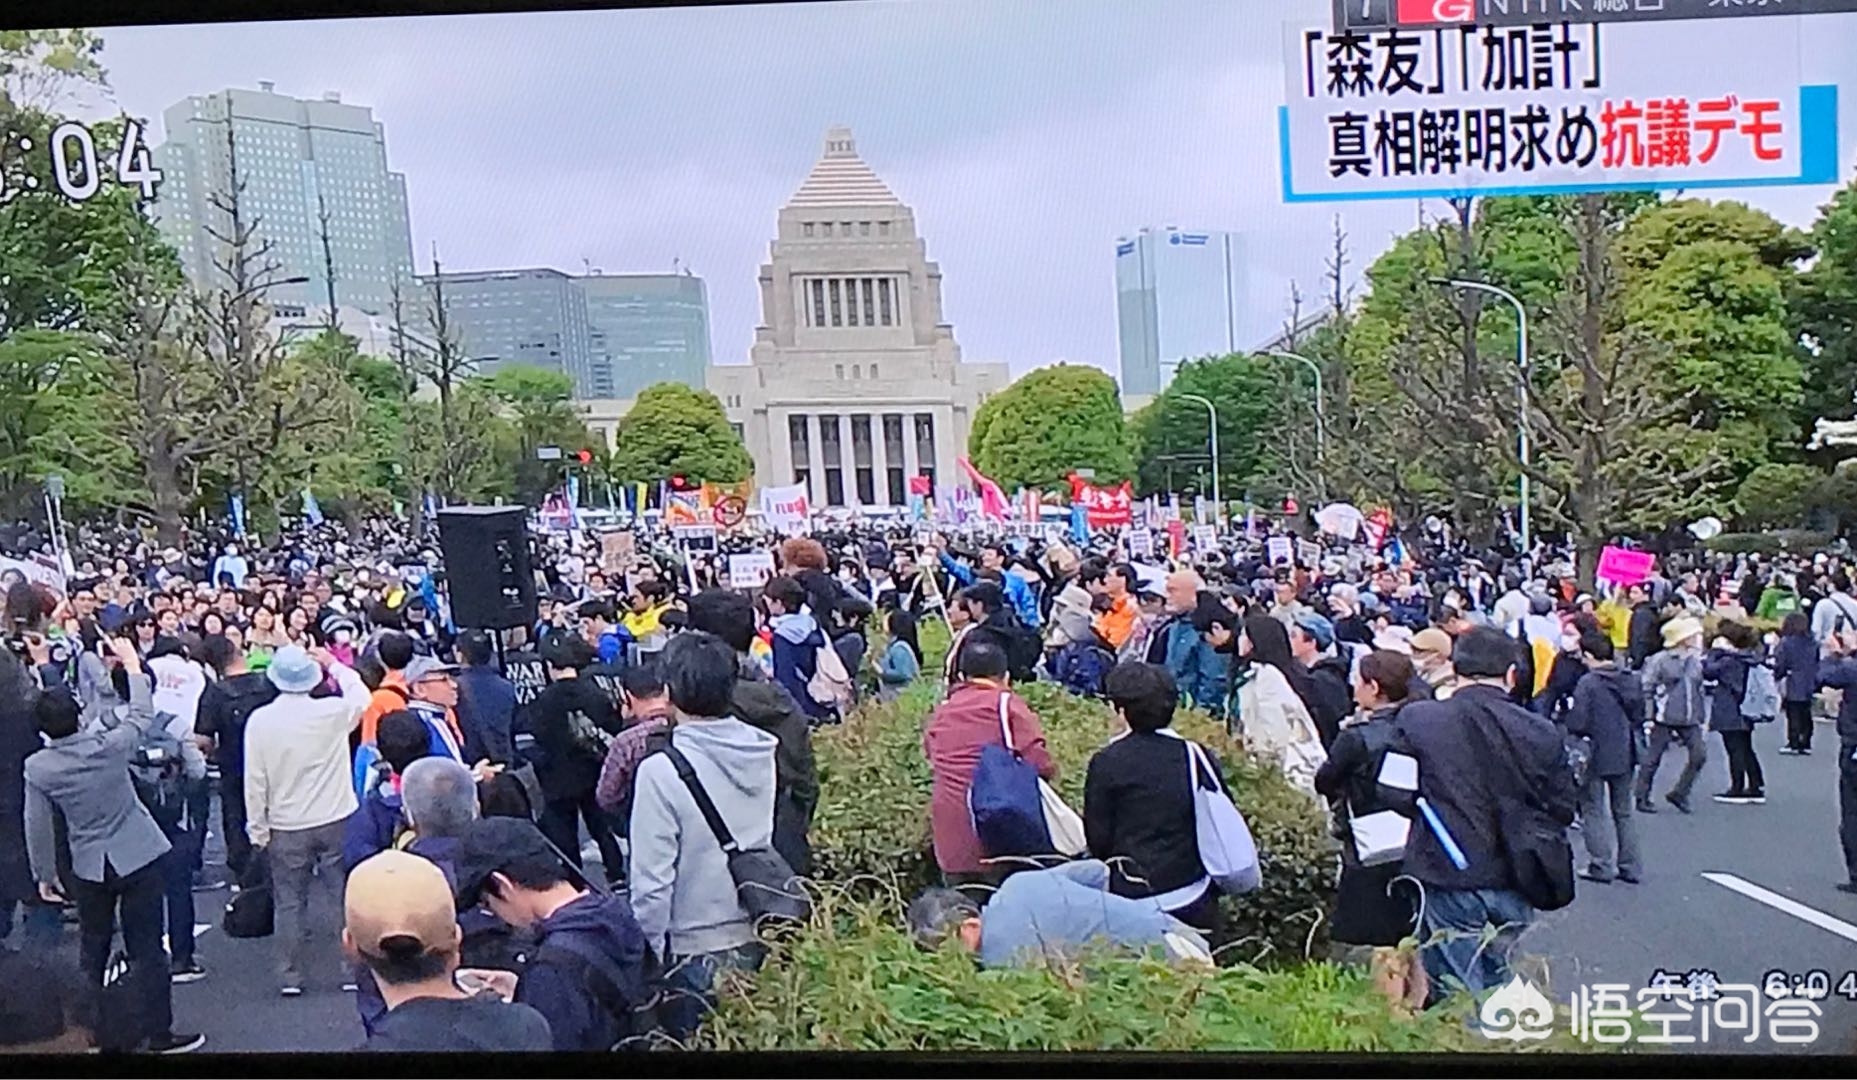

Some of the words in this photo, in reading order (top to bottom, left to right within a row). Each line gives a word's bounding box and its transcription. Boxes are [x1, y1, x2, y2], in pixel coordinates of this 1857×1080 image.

[1431, 0, 1471, 22] G
[1304, 21, 1600, 98] 「森友」「加計」
[0, 121, 162, 199] :04
[1328, 95, 1783, 177] 真相解明求め抗議デモ
